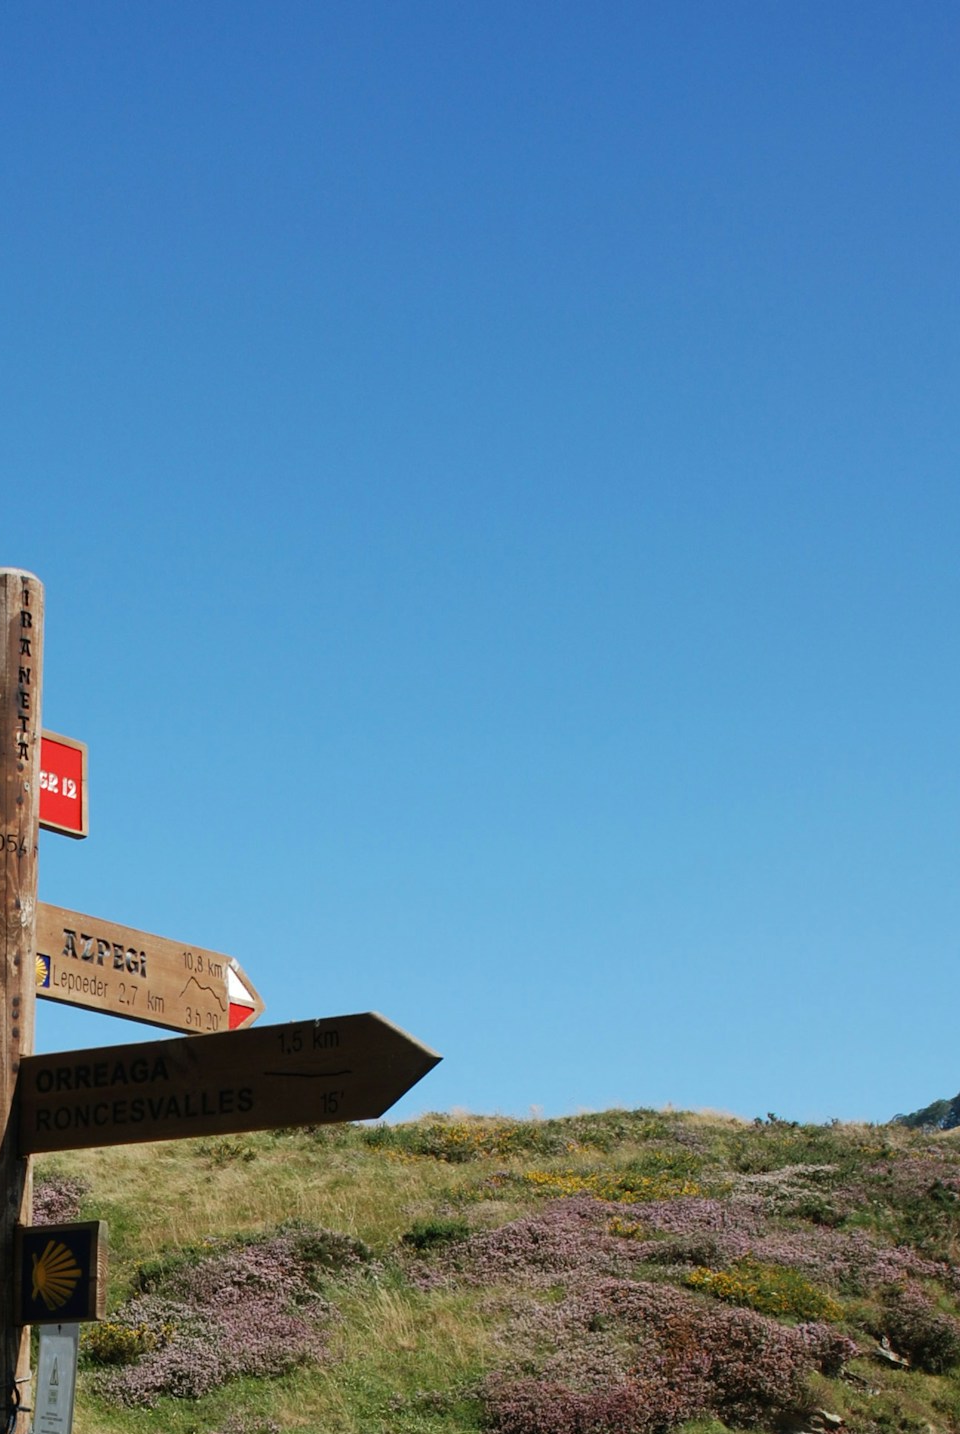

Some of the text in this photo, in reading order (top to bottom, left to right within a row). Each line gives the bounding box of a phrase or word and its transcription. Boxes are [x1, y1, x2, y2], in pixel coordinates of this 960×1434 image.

[40, 770, 78, 800] GR 12
[182, 951, 224, 977] 10,8 km
[52, 964, 165, 1014] Lepoeder 2,7 km
[277, 1029, 340, 1054] 1,5 km
[35, 1056, 169, 1094] ORREAGA
[35, 1087, 254, 1132] RONCESVALLES
[319, 1091, 345, 1115] 15'
